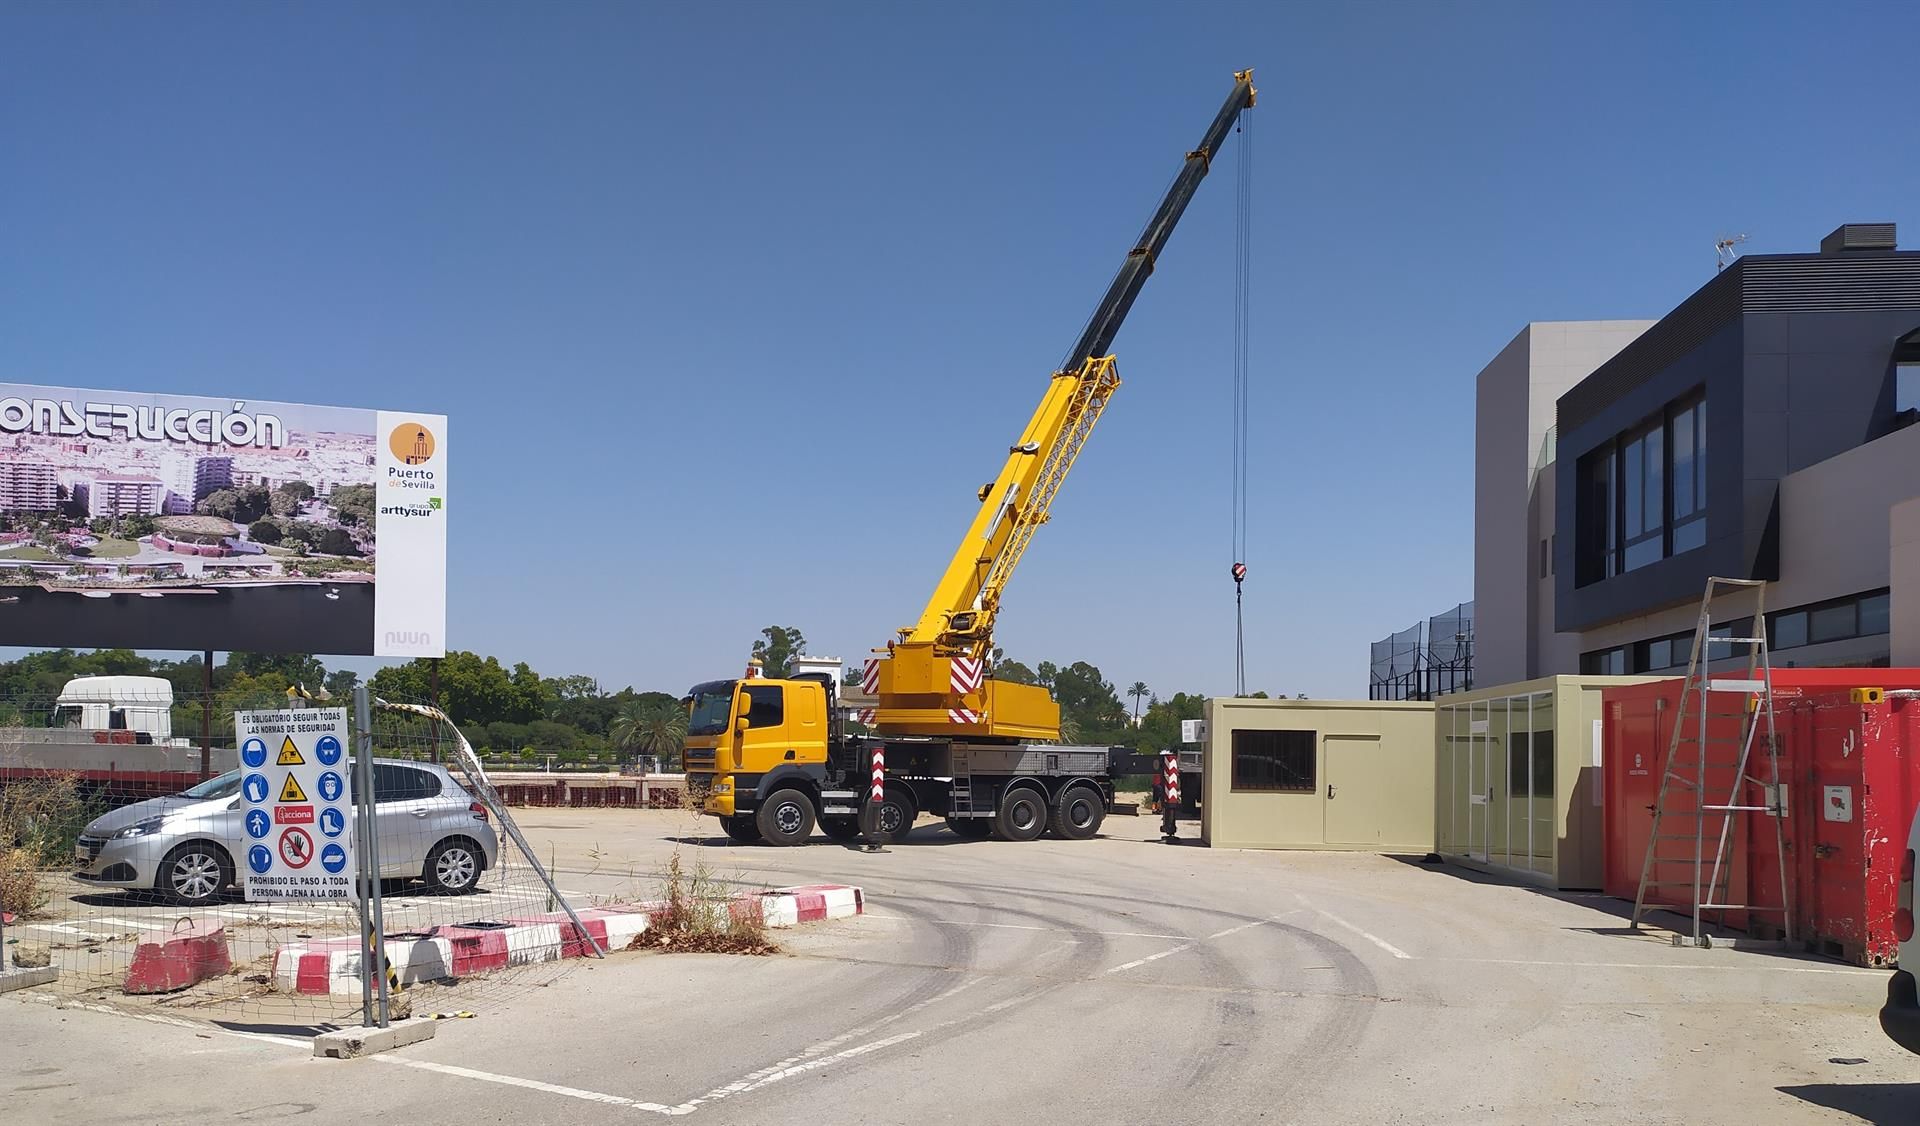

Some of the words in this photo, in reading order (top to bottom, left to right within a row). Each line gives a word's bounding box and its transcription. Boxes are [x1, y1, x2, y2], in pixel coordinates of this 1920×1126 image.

[388, 467, 434, 480] Puerto
[381, 506, 432, 517] arttysur
[242, 715, 250, 724] ES
[252, 714, 291, 723] OBLIGATORIO
[293, 713, 318, 722] SEGUIR
[320, 712, 341, 721] TODAS
[247, 726, 260, 734] LAS
[261, 725, 285, 734] NORMAS
[287, 725, 295, 733] DE
[297, 723, 336, 733] SEGURIDAD
[284, 810, 312, 819] acciona
[249, 876, 288, 885] PROHIBIDO
[290, 877, 298, 885] EL
[300, 877, 320, 885] PASO
[322, 877, 327, 885] A
[329, 877, 349, 885] TODA
[252, 888, 283, 897] PERSONA
[285, 889, 308, 898] AJENA
[310, 889, 315, 898] A
[317, 889, 327, 898] LA
[328, 889, 348, 898] OBRA
